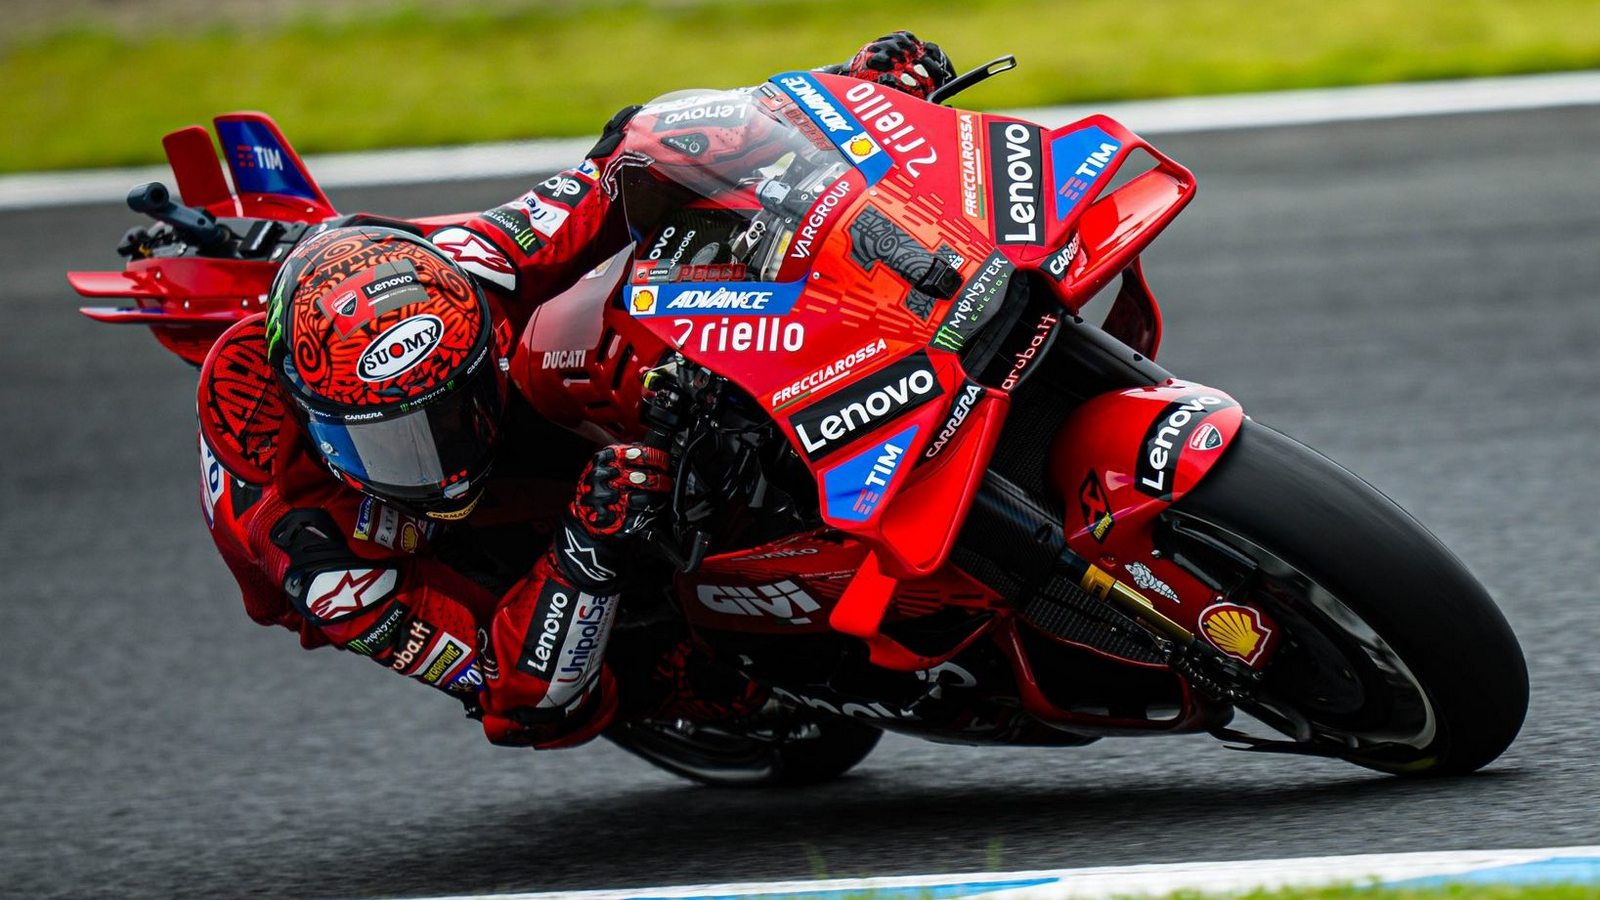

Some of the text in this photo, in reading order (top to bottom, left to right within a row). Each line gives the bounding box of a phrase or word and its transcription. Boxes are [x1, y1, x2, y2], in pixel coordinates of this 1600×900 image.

[664, 104, 747, 126] Lenovo
[785, 75, 854, 132] ADVANCE
[847, 82, 926, 154] riello
[253, 146, 283, 171] TIM
[959, 114, 979, 218] FRECCIAROSSA
[1075, 142, 1118, 178] TIM
[1004, 123, 1037, 242] Lenovo
[791, 180, 852, 260] VARGROUP
[366, 274, 413, 296] Lenovo
[677, 264, 747, 281] PECCO
[950, 257, 1009, 328] MONSTER
[666, 290, 773, 310] ADVANCE
[970, 273, 1009, 321] ENERGY
[364, 326, 437, 371] SUOMY
[700, 317, 805, 352] riello
[1001, 313, 1057, 390] aruba.it
[542, 350, 586, 369] DUCATI
[771, 338, 887, 406] FRECCIAROSSA
[344, 411, 384, 421] CARRERA
[795, 369, 934, 453] Lenovo
[925, 384, 982, 458] CARRERA
[865, 443, 904, 488] TIM
[1141, 395, 1222, 491] Lenovo
[696, 580, 822, 625] GIVI
[363, 608, 403, 644] MONSTER
[527, 592, 568, 672] Lenovo
